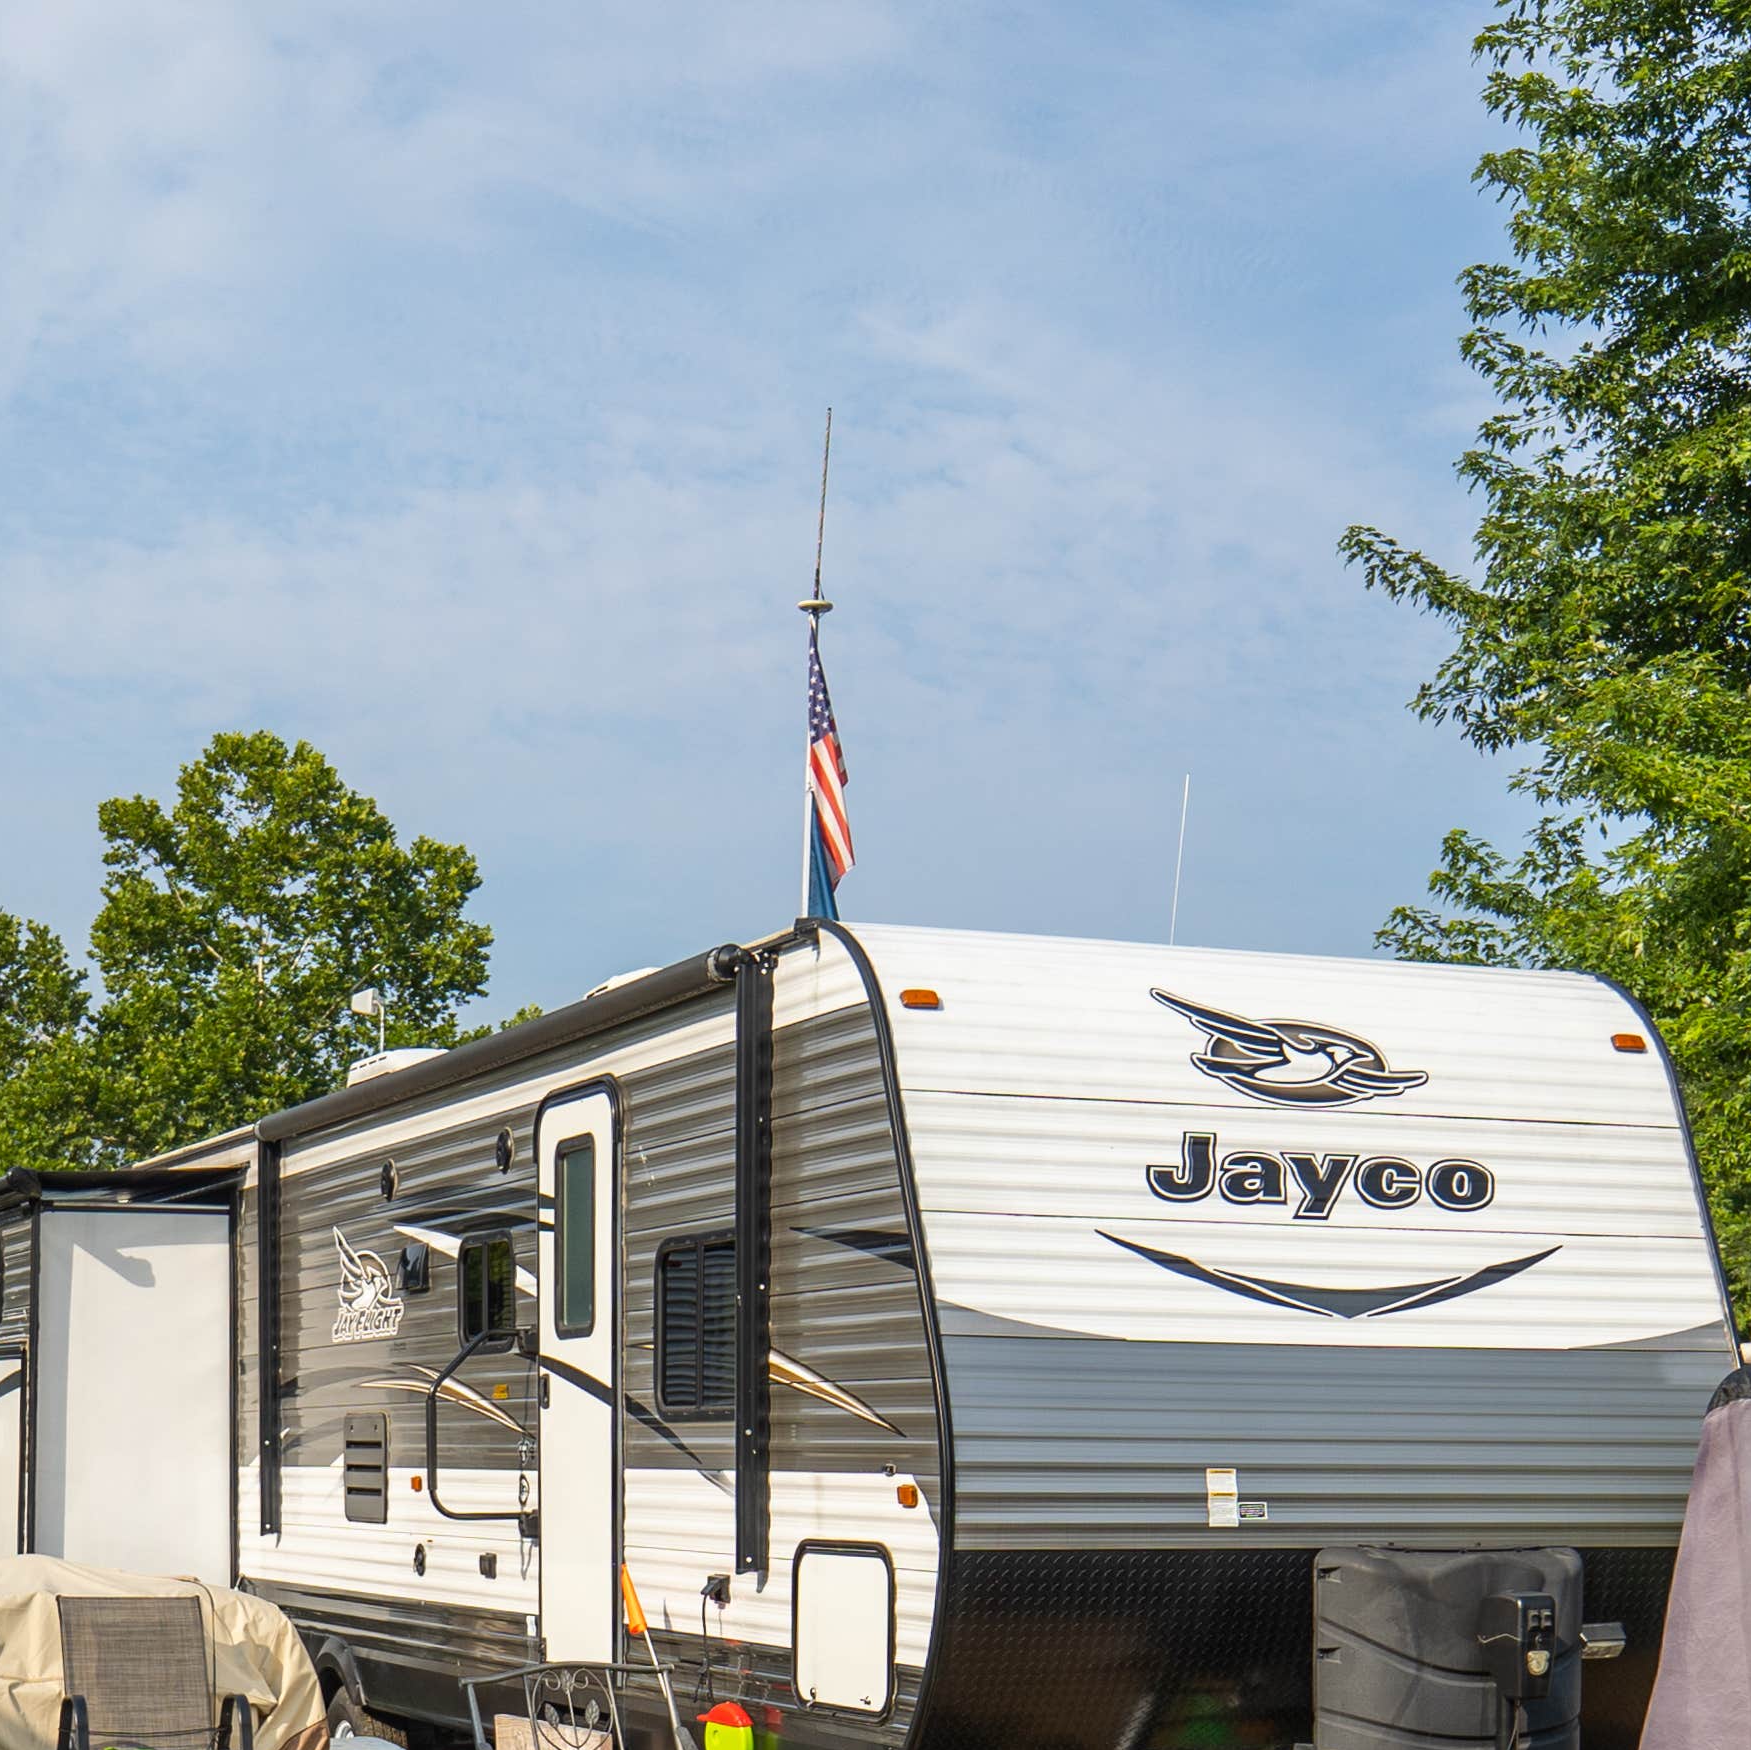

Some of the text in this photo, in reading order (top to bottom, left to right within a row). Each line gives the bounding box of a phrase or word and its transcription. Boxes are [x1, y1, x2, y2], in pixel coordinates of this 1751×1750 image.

[1145, 1130, 1496, 1221] Jayco
[332, 1305, 404, 1342] JAY FLIGHT
